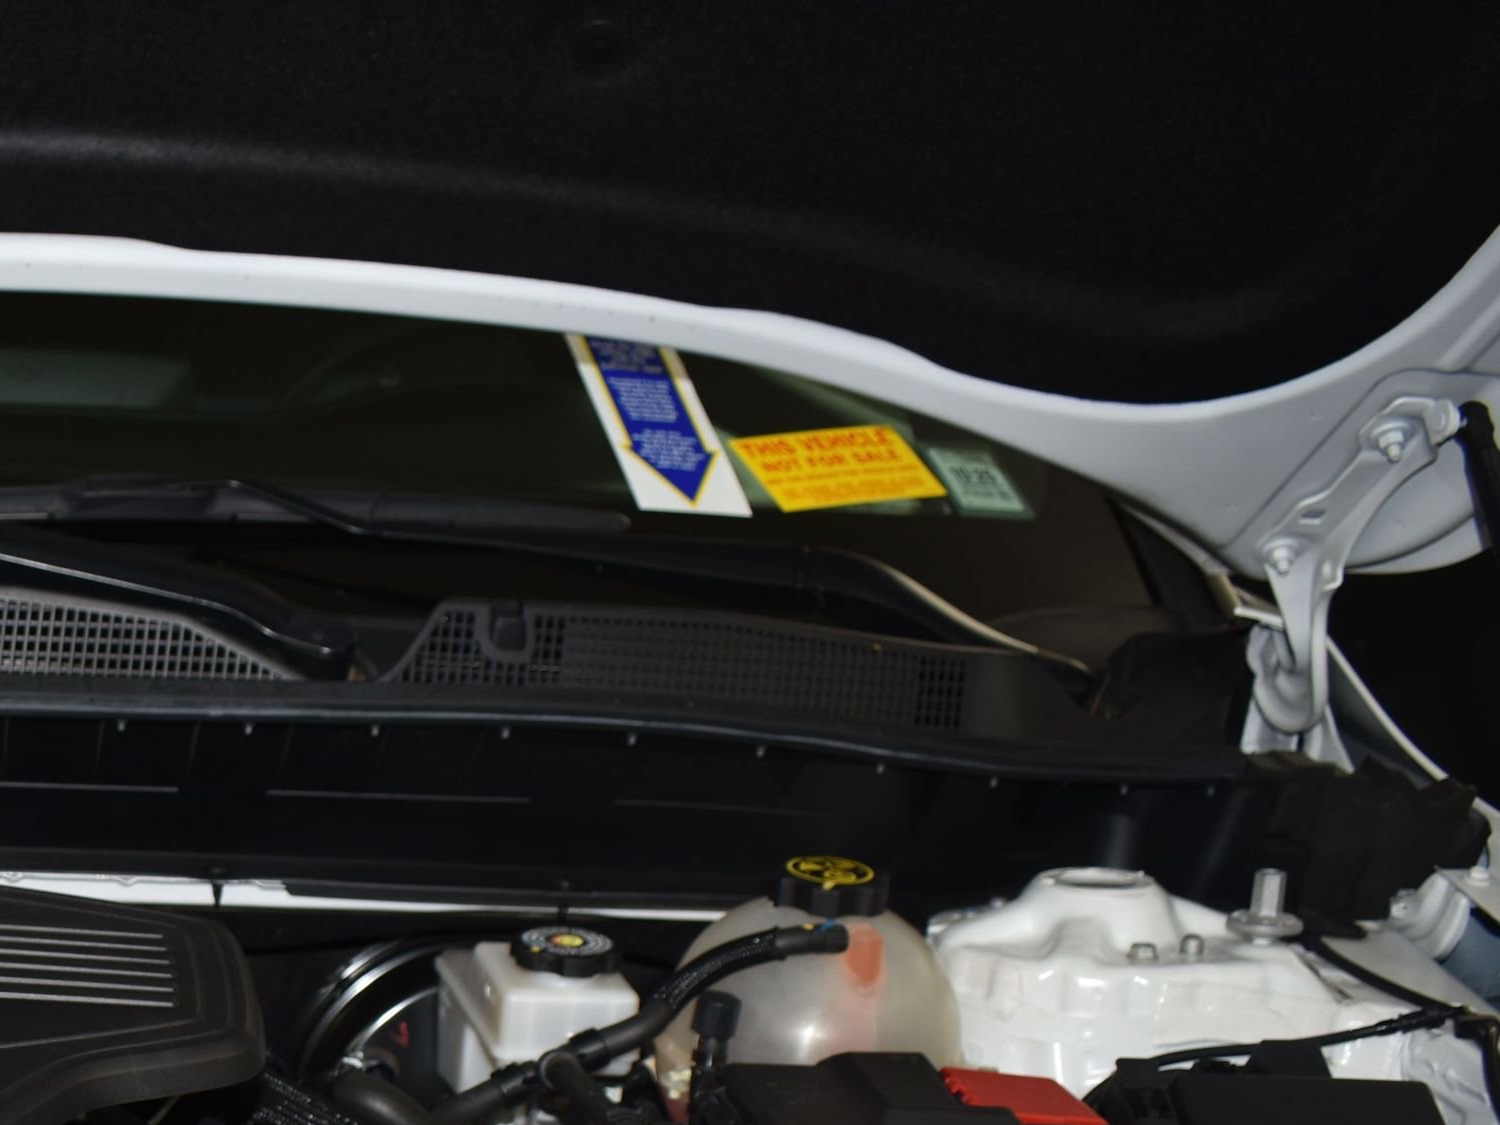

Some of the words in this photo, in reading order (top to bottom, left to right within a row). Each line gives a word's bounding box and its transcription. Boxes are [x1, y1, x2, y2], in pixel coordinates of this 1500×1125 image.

[740, 438, 797, 459] THIS
[801, 426, 889, 451] VEHICLE
[760, 457, 800, 473] NOT
[806, 451, 847, 468] FOR
[852, 448, 900, 465] SALE
